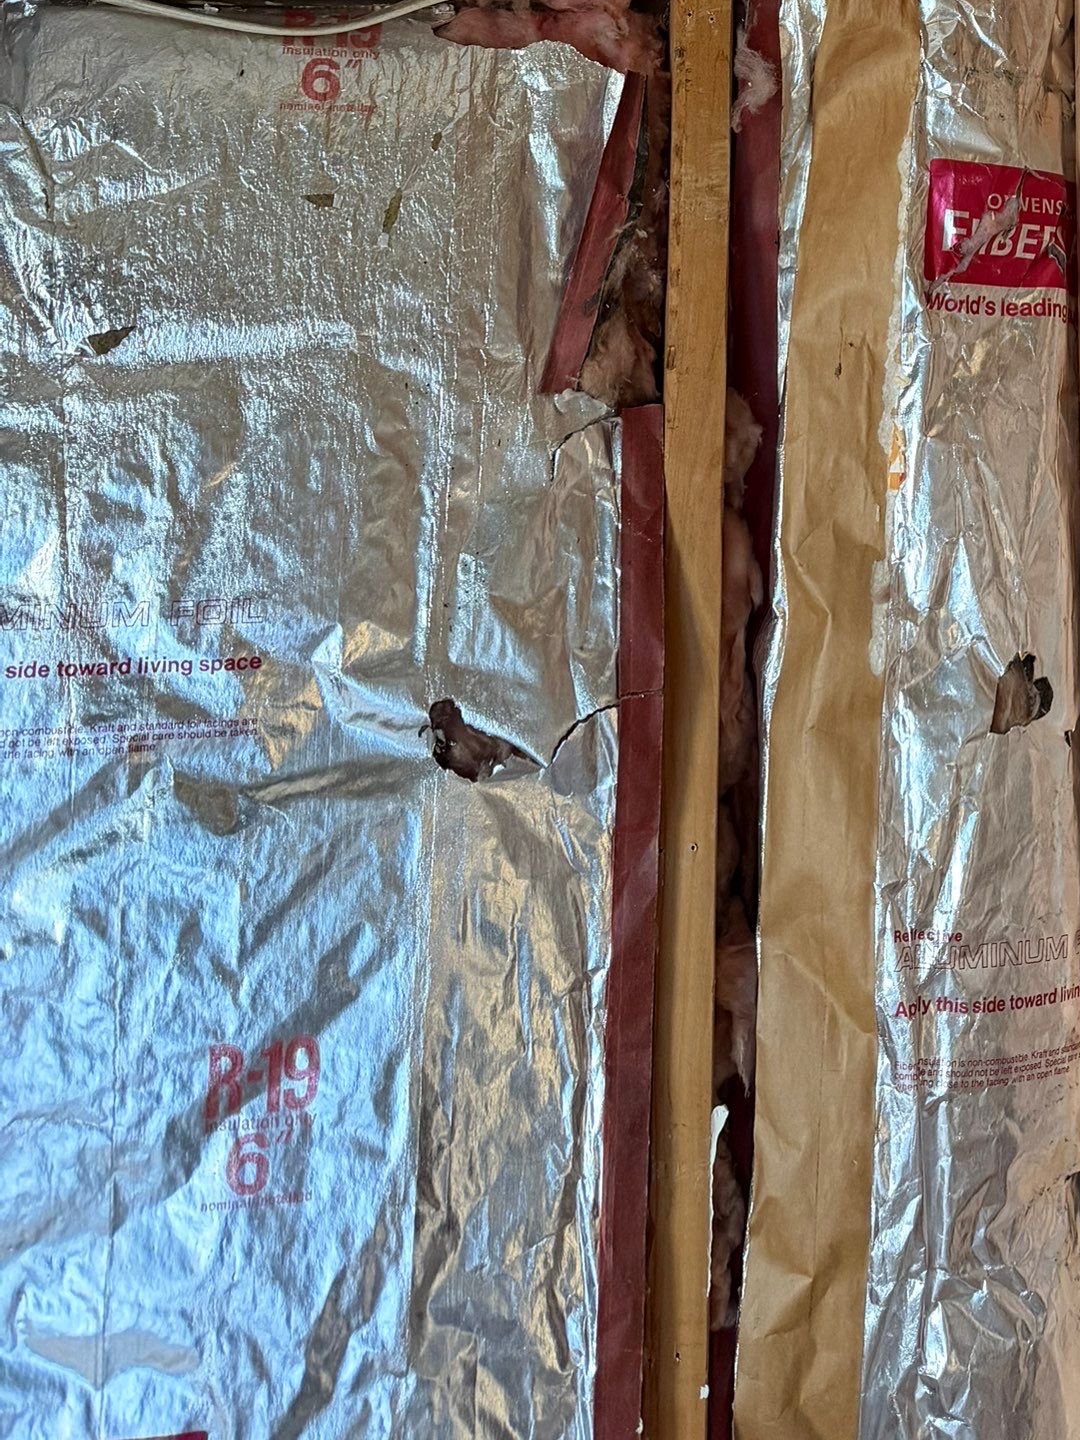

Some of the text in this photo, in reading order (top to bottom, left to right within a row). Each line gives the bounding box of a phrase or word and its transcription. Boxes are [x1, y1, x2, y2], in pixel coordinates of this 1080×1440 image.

[282, 45, 381, 60] insulation only
[924, 291, 1069, 324] World's leading
[5, 655, 263, 679] side toward living space
[177, 729, 212, 740] should
[936, 996, 969, 1014] this
[972, 995, 1006, 1014] side
[1009, 987, 1057, 1009] toward
[203, 1033, 321, 1121] R-19
